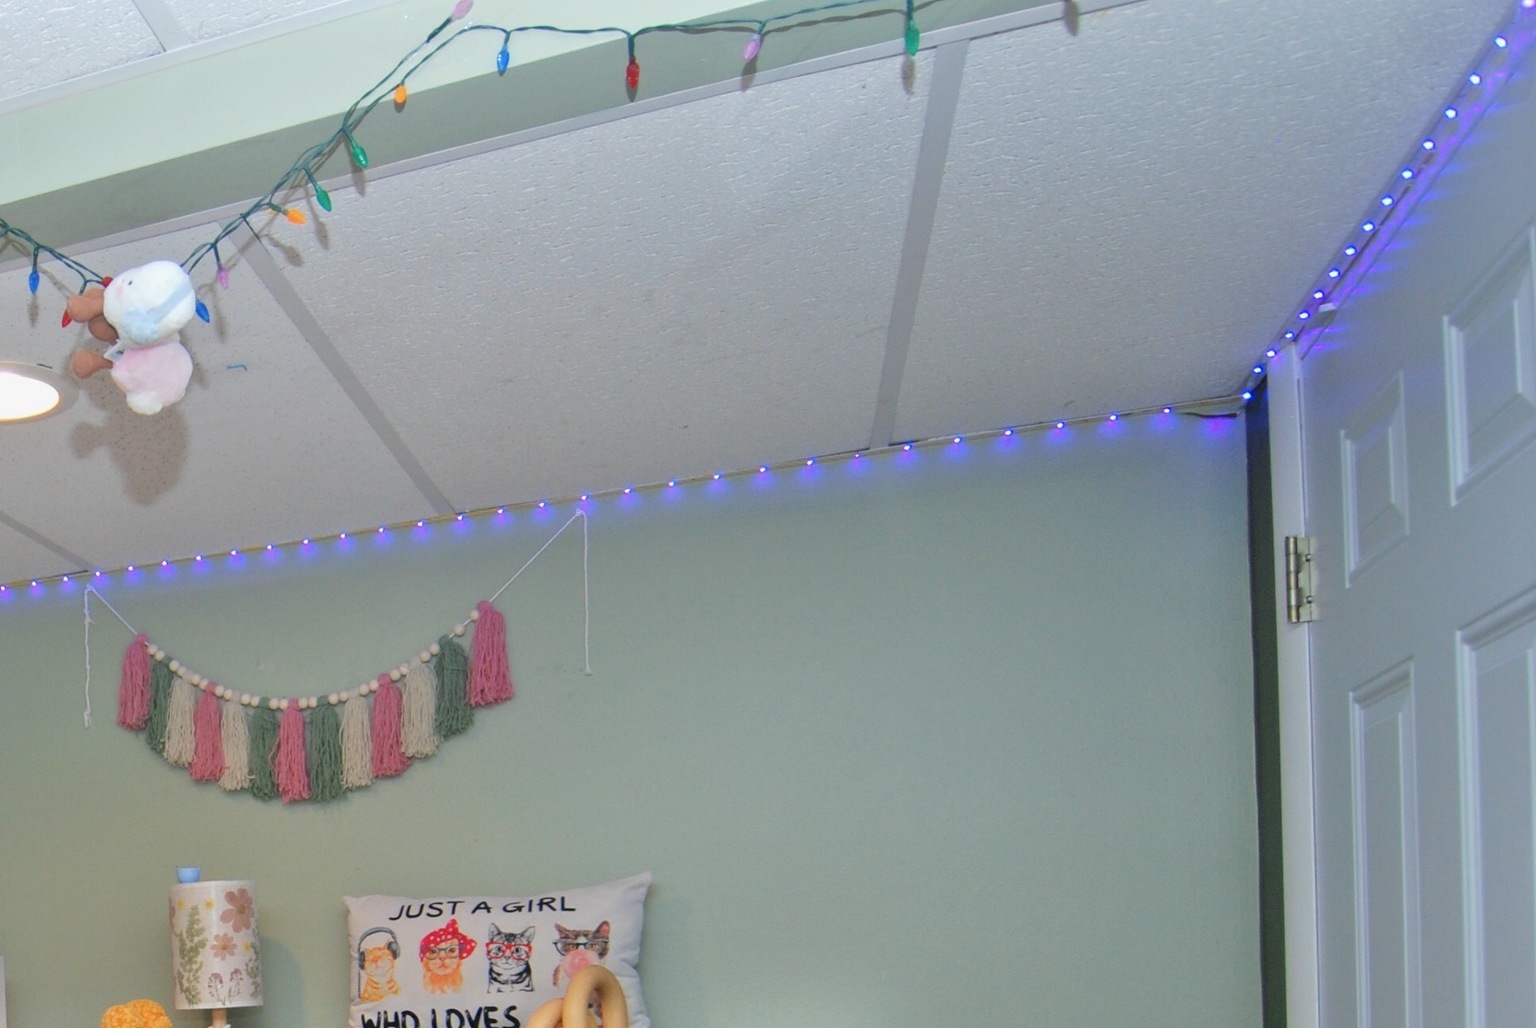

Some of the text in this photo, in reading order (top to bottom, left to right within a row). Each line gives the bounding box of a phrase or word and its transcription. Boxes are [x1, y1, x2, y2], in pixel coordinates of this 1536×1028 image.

[389, 896, 576, 921] JUST A GIRL
